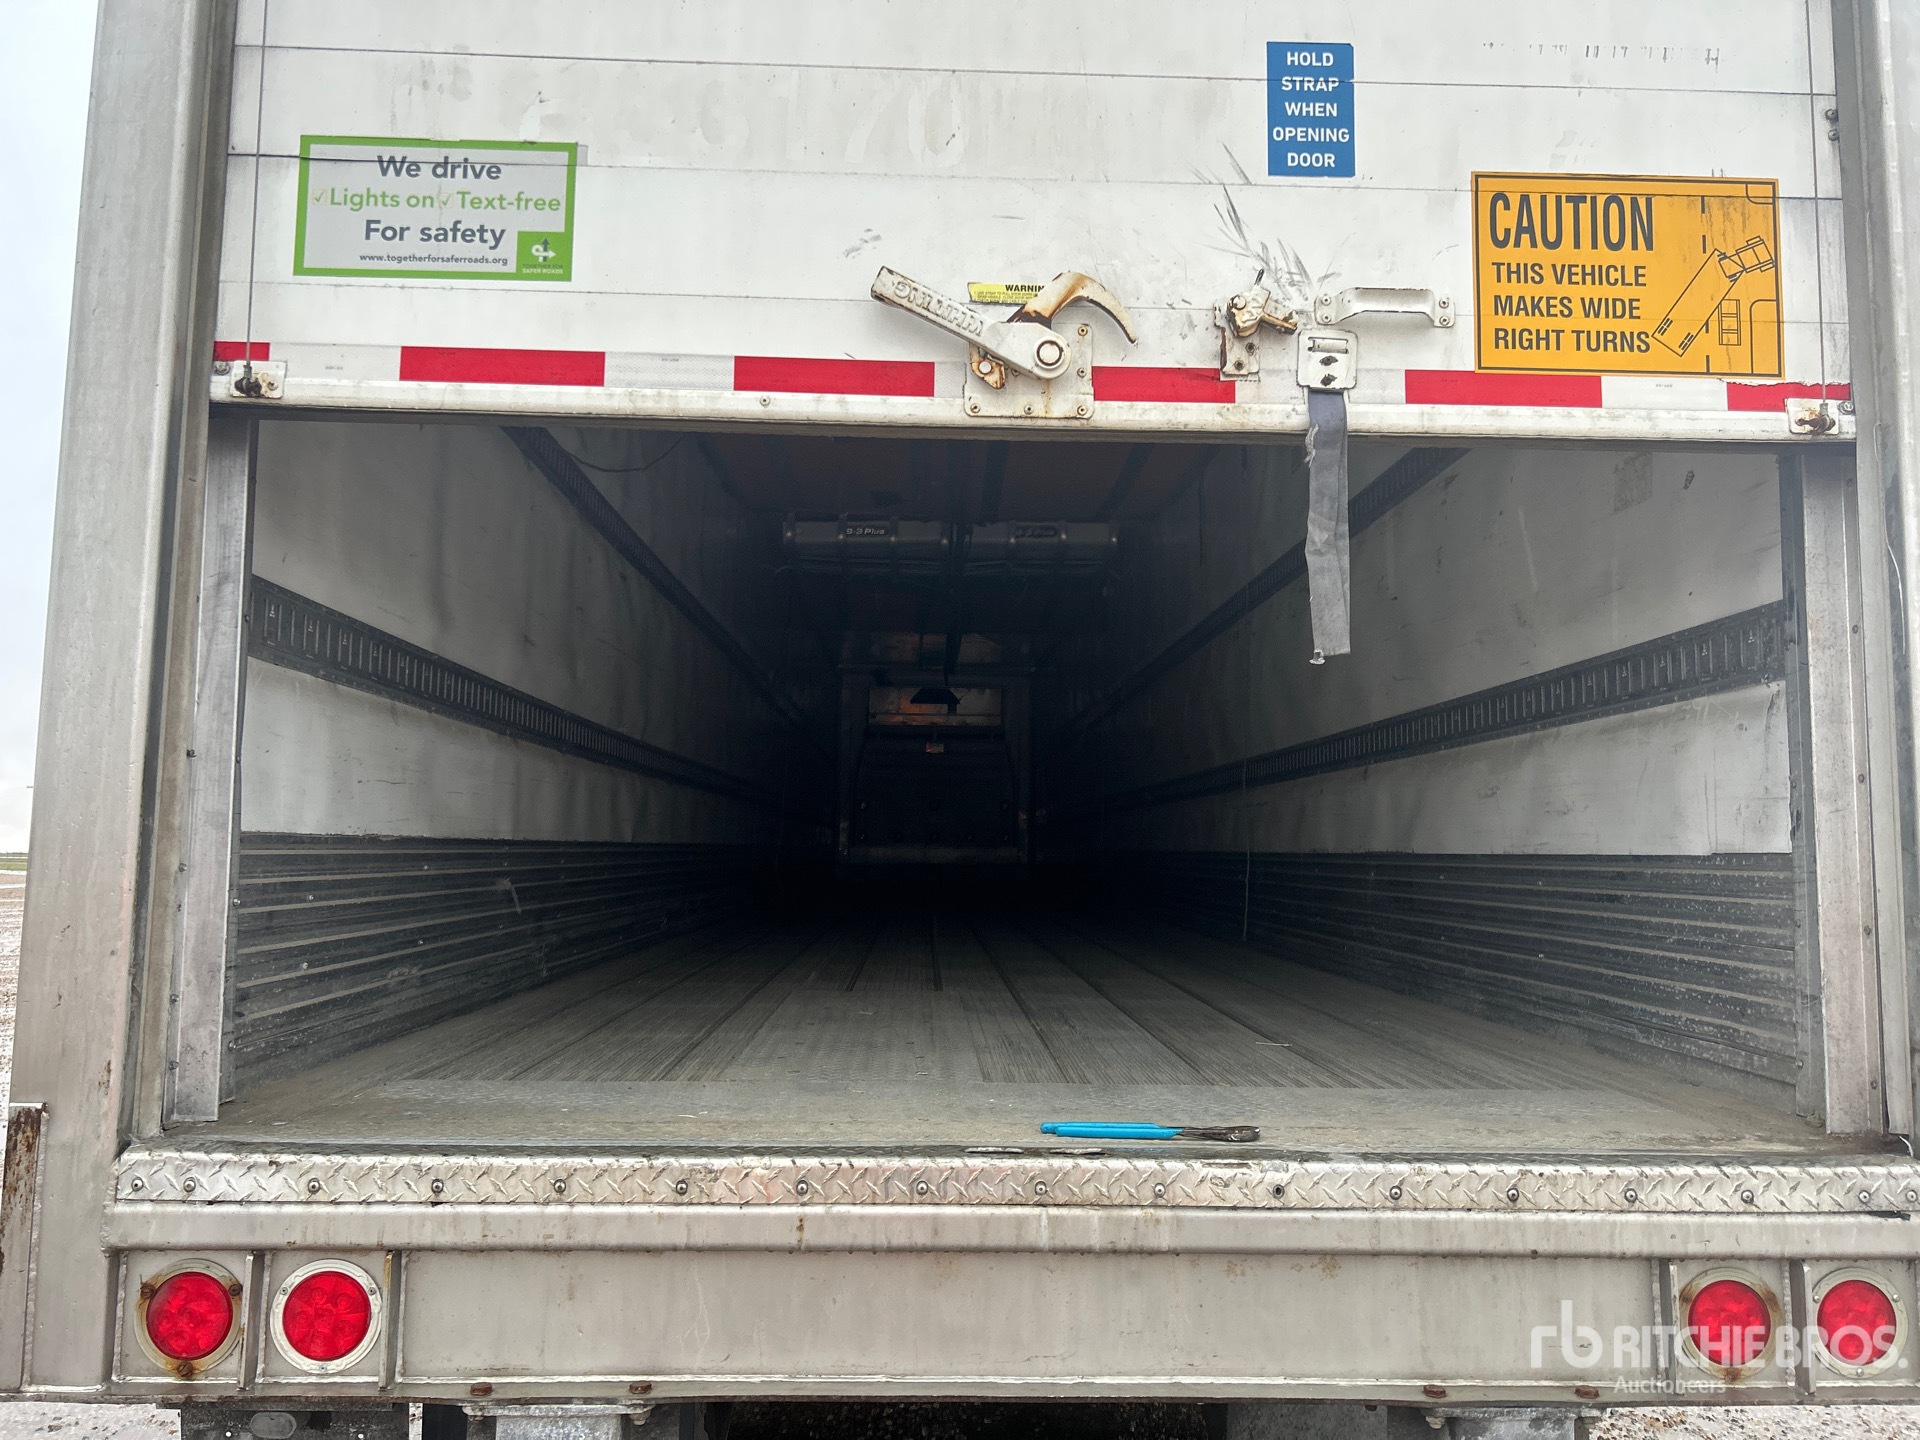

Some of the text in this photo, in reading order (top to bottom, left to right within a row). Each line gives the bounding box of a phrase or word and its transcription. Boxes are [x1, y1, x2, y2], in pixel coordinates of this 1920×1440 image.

[1286, 51, 1334, 67] HOLD
[1281, 76, 1339, 92] STRAP
[1284, 101, 1338, 117] WHEN
[1272, 126, 1350, 143] OPENING
[376, 155, 502, 180] We drive
[1287, 152, 1336, 168] DOOR
[330, 188, 561, 212] Lights on Text-free
[1489, 191, 1654, 252] CAUTION
[364, 219, 506, 250] For safety
[359, 252, 509, 266] www.togetherforsaferroads.org
[1491, 262, 1647, 287] THIS VEHICLE
[1493, 295, 1641, 320] MAKES WIDE
[1494, 327, 1651, 353] RIGHT TURNS
